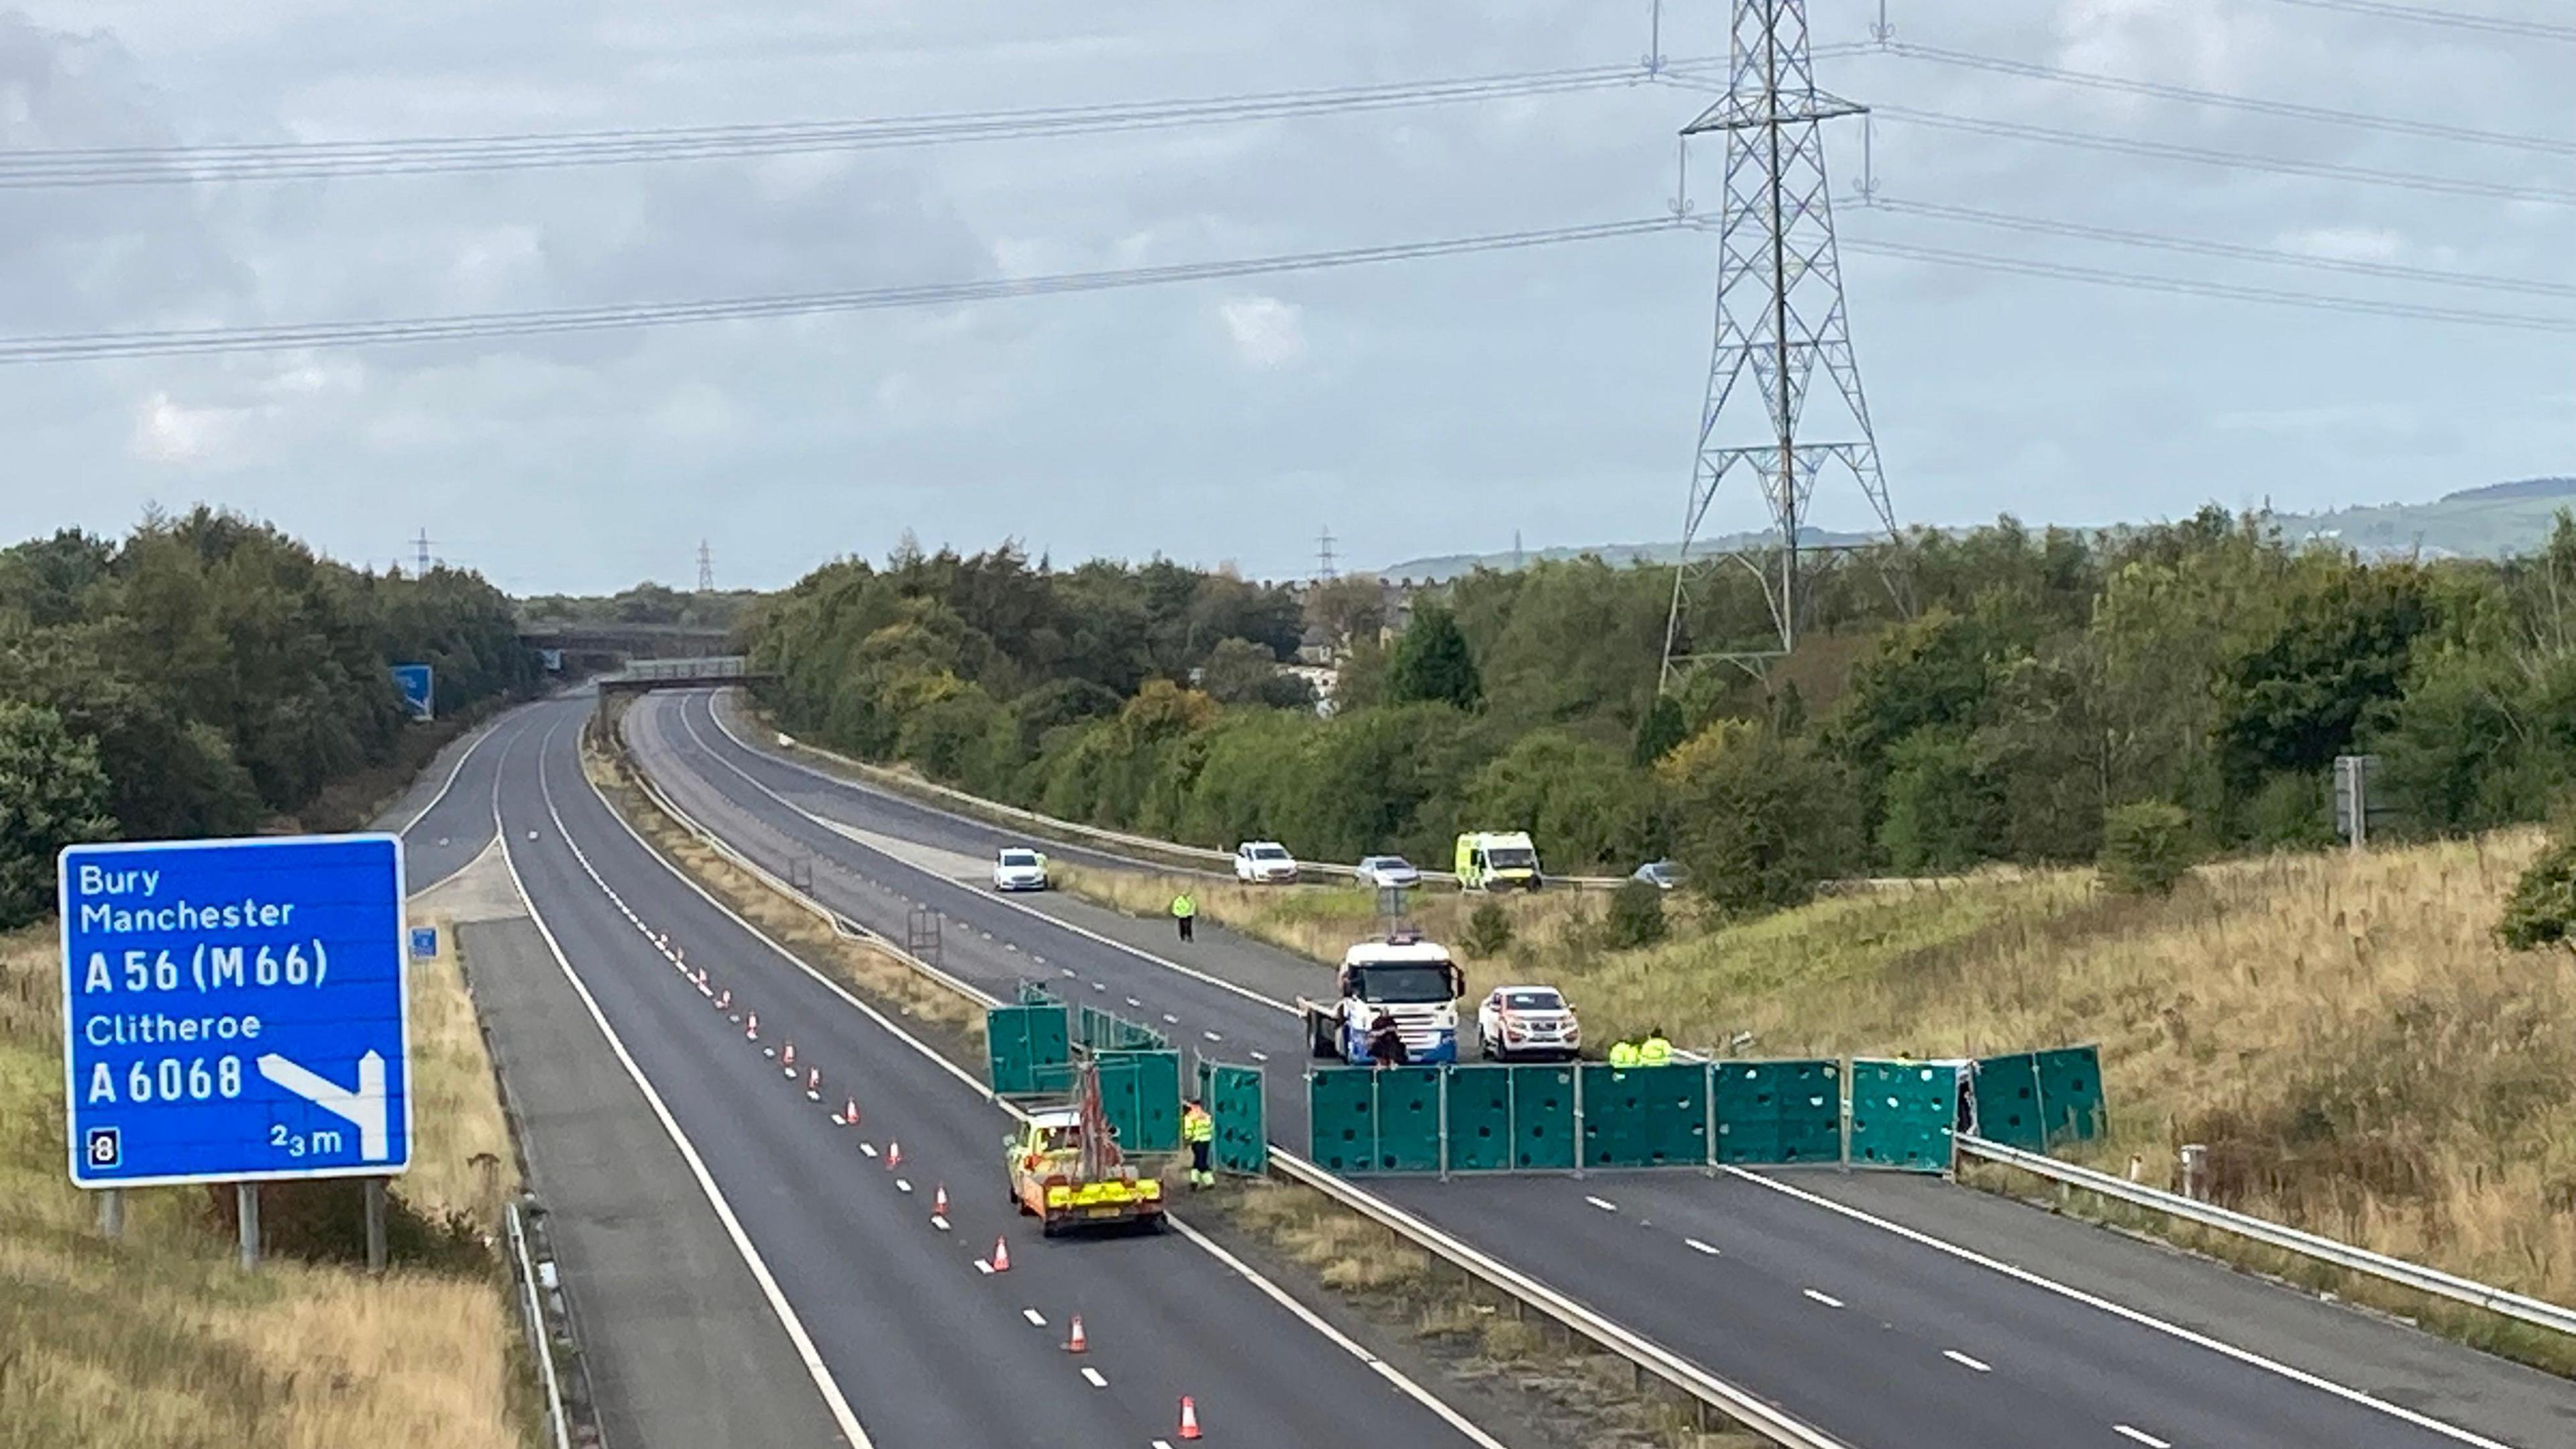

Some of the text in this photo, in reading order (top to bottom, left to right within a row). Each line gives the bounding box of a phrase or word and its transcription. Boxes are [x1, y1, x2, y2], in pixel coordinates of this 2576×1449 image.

[81, 866, 158, 898] Bury
[82, 899, 294, 933] Manchester
[87, 1016, 260, 1045] Clitheroe
[93, 1136, 114, 1161] 8
